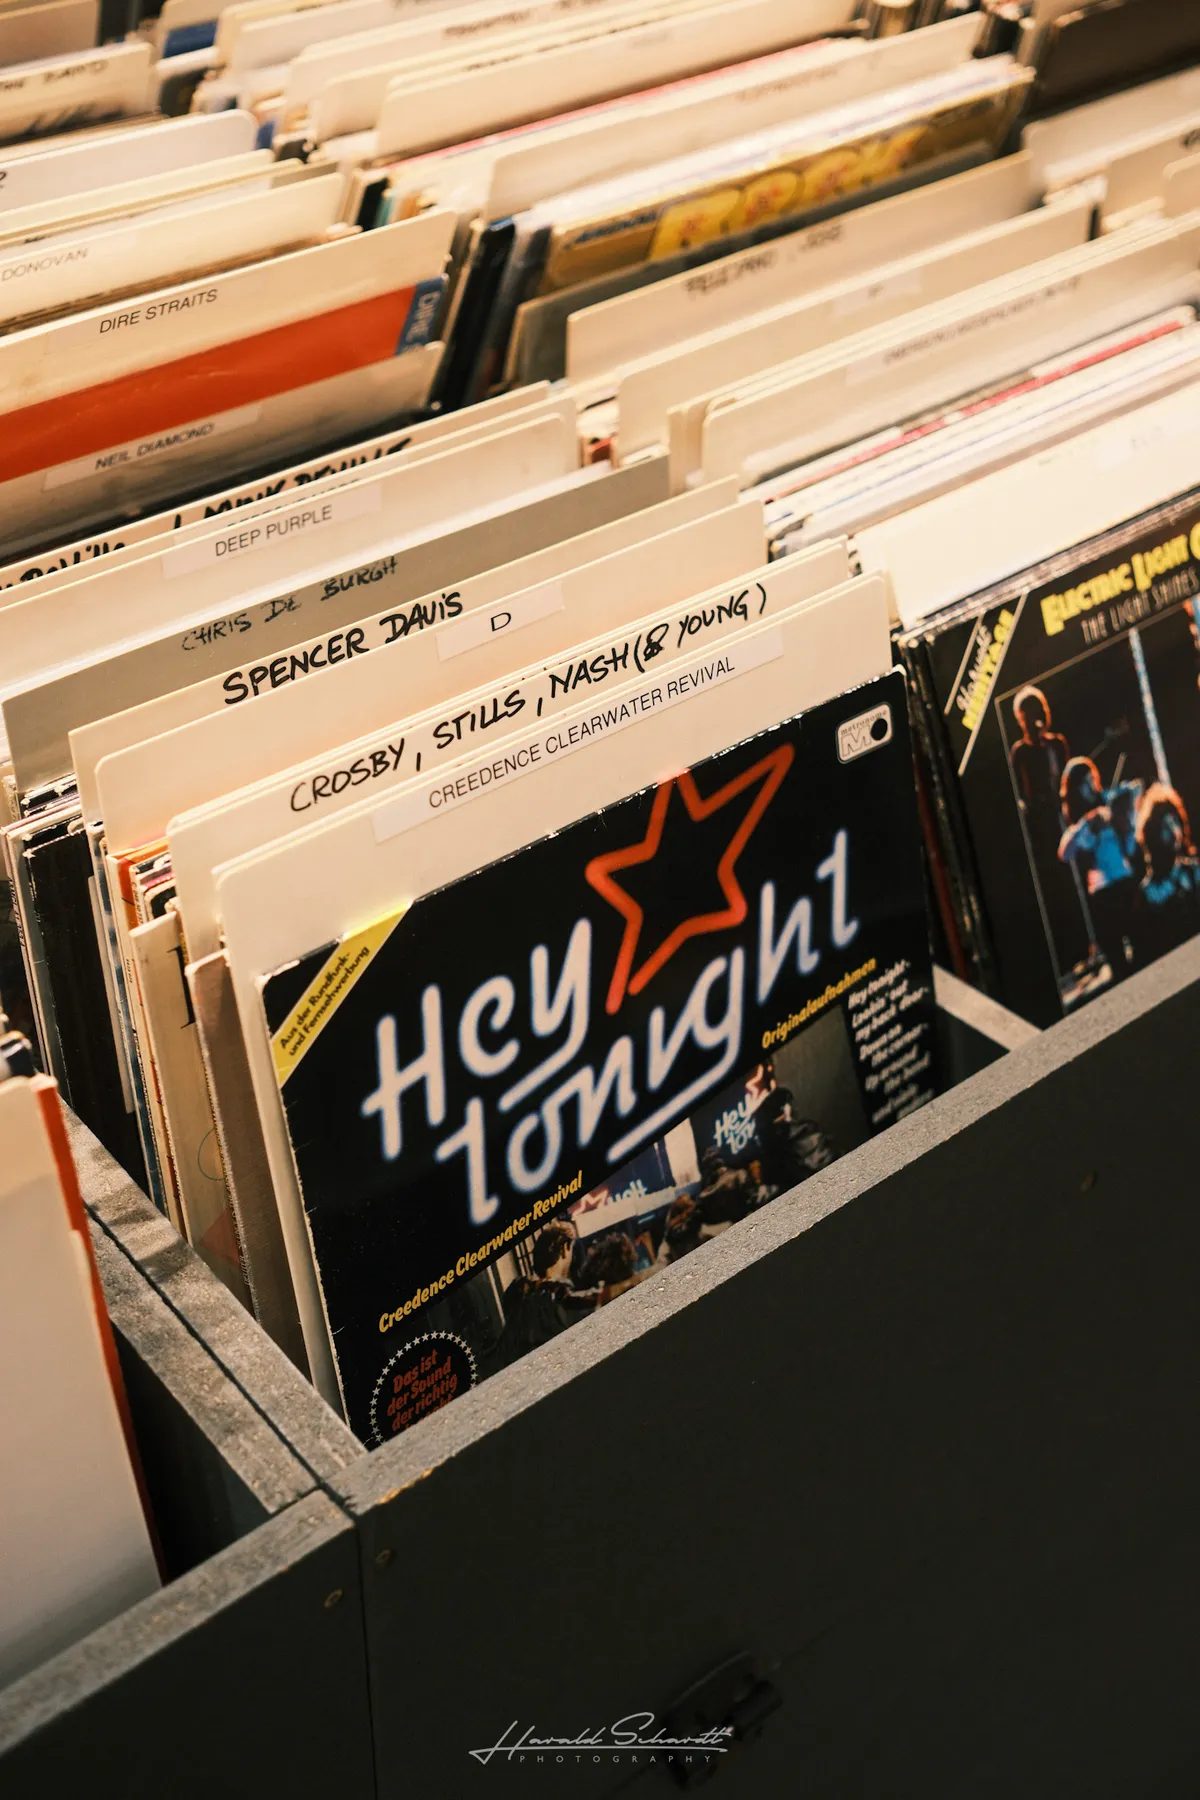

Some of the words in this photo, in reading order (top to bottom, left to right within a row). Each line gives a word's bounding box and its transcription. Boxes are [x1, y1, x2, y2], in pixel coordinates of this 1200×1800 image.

[1, 247, 90, 281] DONOVAN
[99, 310, 140, 334] DIRE
[146, 288, 218, 323] STRAITS
[95, 450, 135, 472] NEIL
[137, 422, 216, 458] DIAMOND
[215, 529, 262, 557] DEEP
[265, 504, 333, 540] PURPLE
[182, 613, 253, 652] CHRIS
[321, 555, 399, 602] BURGH
[490, 612, 512, 633] D
[223, 627, 371, 706] SPENCER
[429, 742, 542, 809] CREEDENCE
[545, 688, 664, 762] CLEARWATER
[667, 656, 736, 712] REVIVAL
[762, 957, 877, 1050] Originalaufnahmen
[361, 916, 592, 1161] Hey
[378, 1266, 455, 1334] Creedence
[456, 1211, 532, 1277] Clearwater
[533, 1169, 583, 1222] Revival
[387, 1391, 410, 1417] der
[411, 1355, 452, 1399] Sound
[392, 1407, 415, 1431] der
[415, 1373, 458, 1415] richtig
[393, 1366, 419, 1395] Das
[421, 1349, 438, 1374] ist
